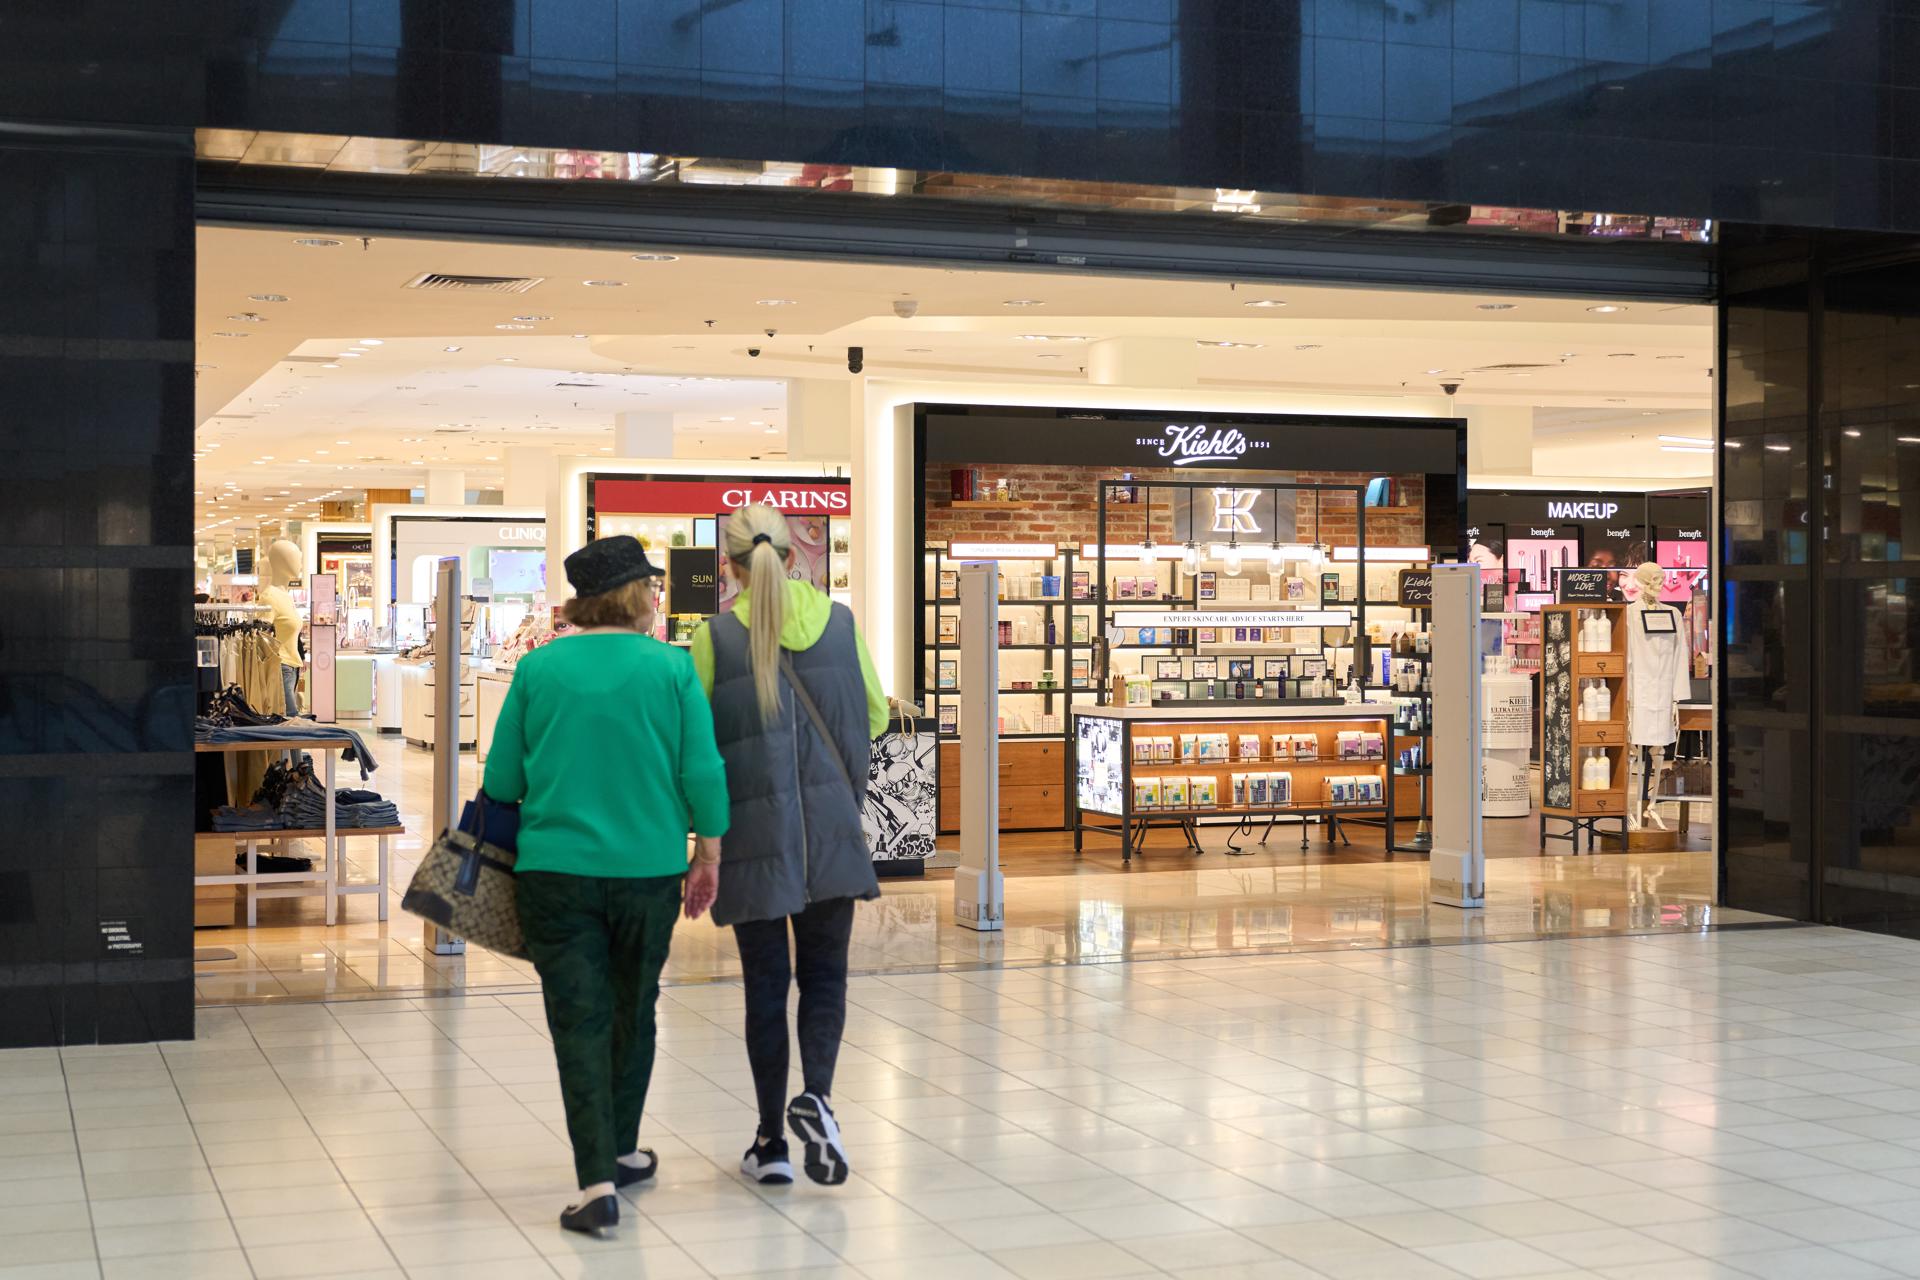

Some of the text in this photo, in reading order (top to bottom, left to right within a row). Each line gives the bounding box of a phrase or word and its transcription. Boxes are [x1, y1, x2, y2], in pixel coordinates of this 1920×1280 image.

[1135, 424, 1270, 457] SINCE Kiehl's 1851
[721, 489, 848, 509] CLARINS
[1548, 502, 1619, 519] MAKEUP
[498, 527, 546, 542] CLINIQ
[1466, 526, 1480, 538] efit
[1530, 528, 1555, 538] benefit
[1606, 528, 1630, 539] benefit
[1678, 529, 1702, 539] benefit
[691, 574, 713, 584] SUN
[1567, 573, 1603, 582] MORE TO
[1574, 582, 1596, 591] LOVE
[1163, 615, 1191, 623] EXPERT
[1192, 615, 1229, 623] SKINCARE
[1231, 615, 1257, 623] ADVICE
[1258, 615, 1285, 623] STARTS
